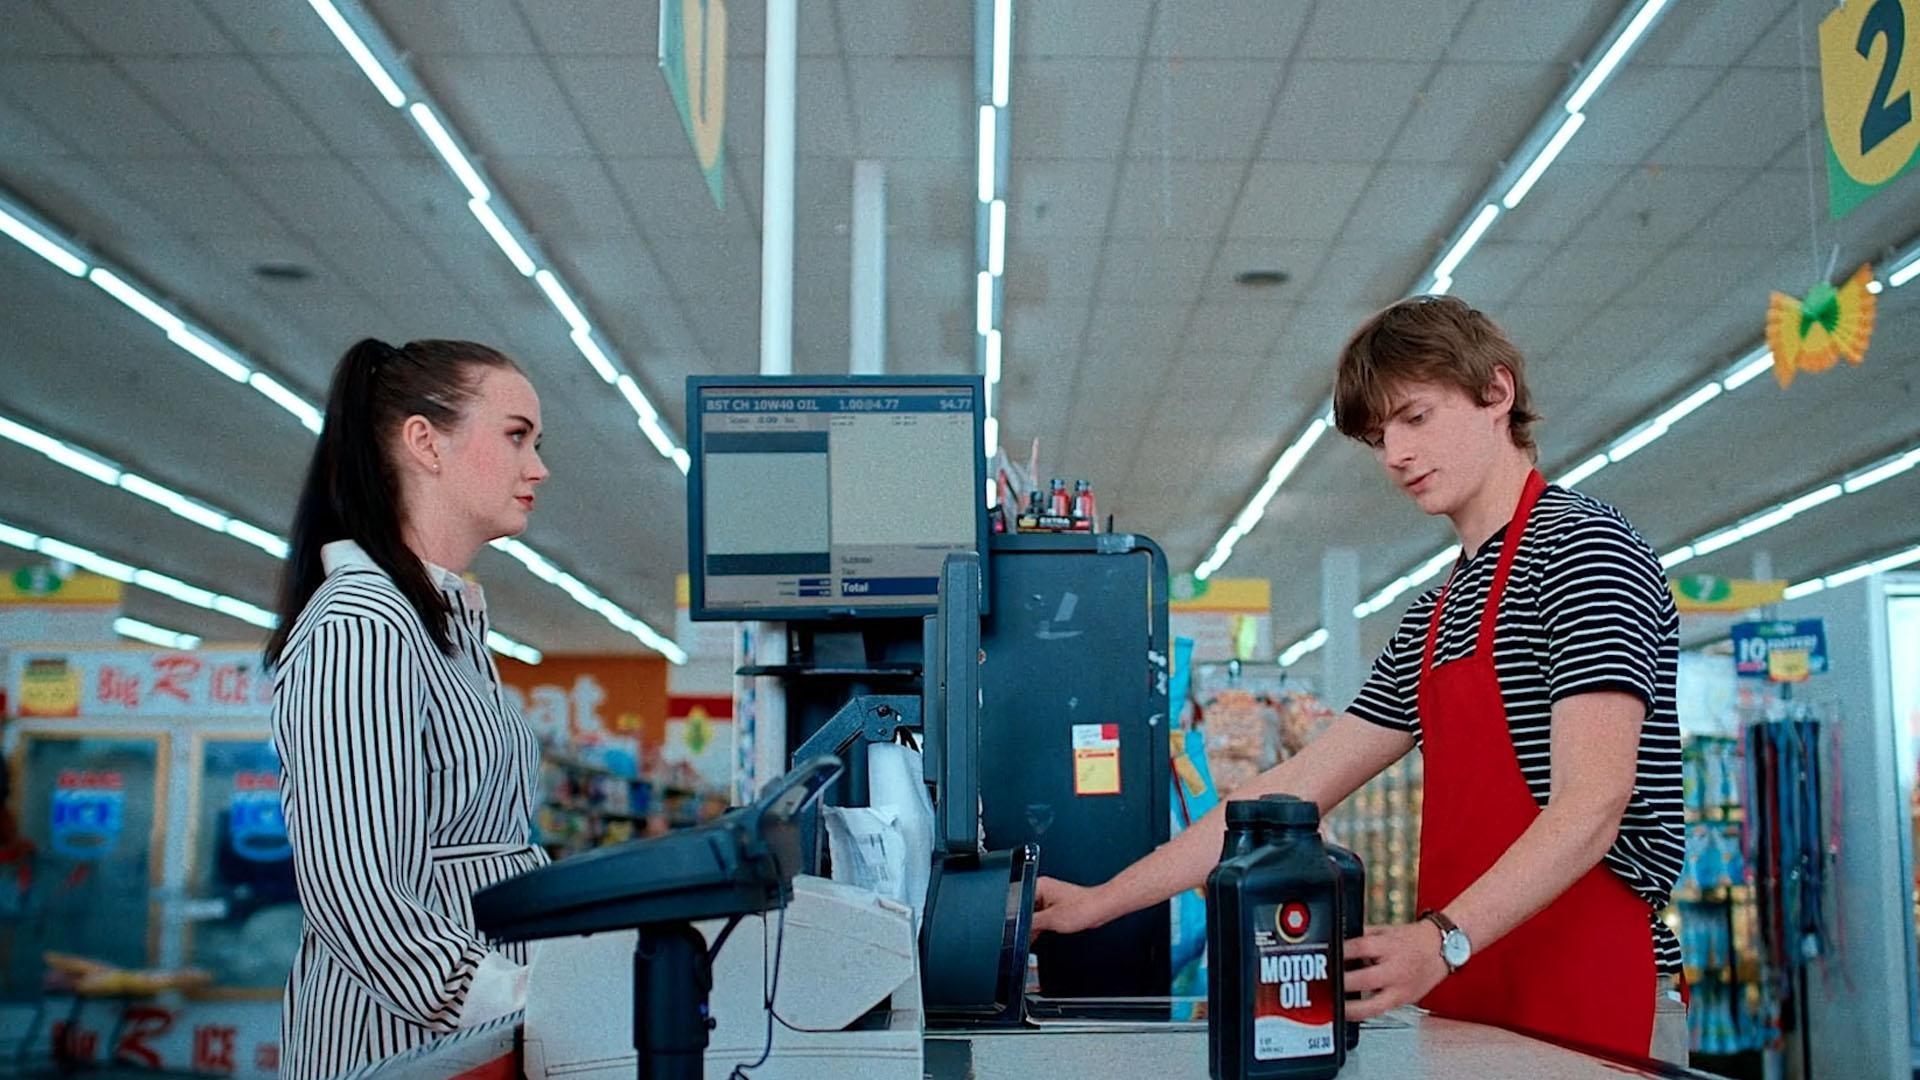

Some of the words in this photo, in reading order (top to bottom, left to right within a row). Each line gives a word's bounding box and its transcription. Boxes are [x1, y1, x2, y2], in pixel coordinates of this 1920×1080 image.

[1856, 0, 1912, 155] 2
[706, 399, 729, 411] BST
[732, 399, 749, 411] CH
[797, 399, 819, 411] OIL
[841, 583, 868, 592] Total
[1697, 576, 1714, 600] 7
[1739, 638, 1766, 662] 10
[1260, 954, 1328, 984] MOTOR
[1279, 982, 1312, 1009] OIL
